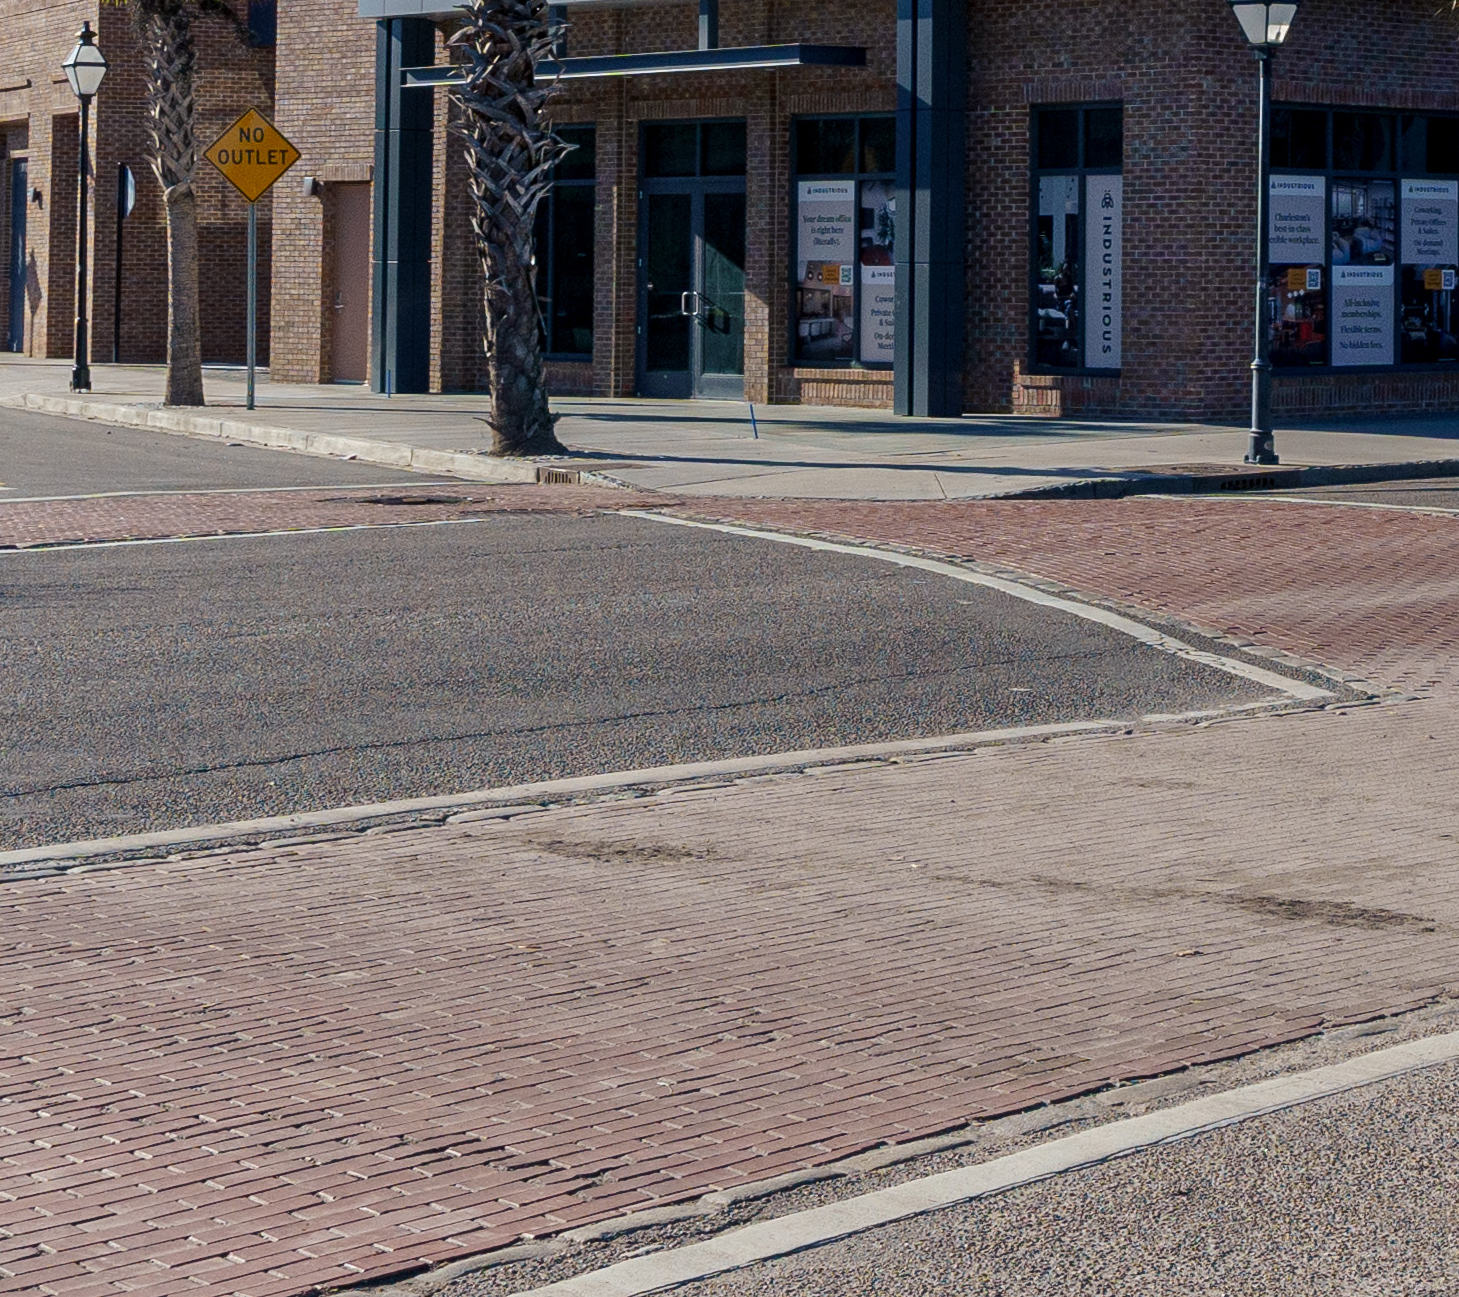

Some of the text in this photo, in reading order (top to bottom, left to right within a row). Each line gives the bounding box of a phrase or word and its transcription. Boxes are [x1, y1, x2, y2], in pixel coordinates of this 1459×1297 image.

[239, 127, 264, 143] NO
[217, 149, 289, 165] OUTLET
[1276, 182, 1315, 190] INDUSTRIOUS
[1102, 216, 1112, 354] INDUSTRIOUS
